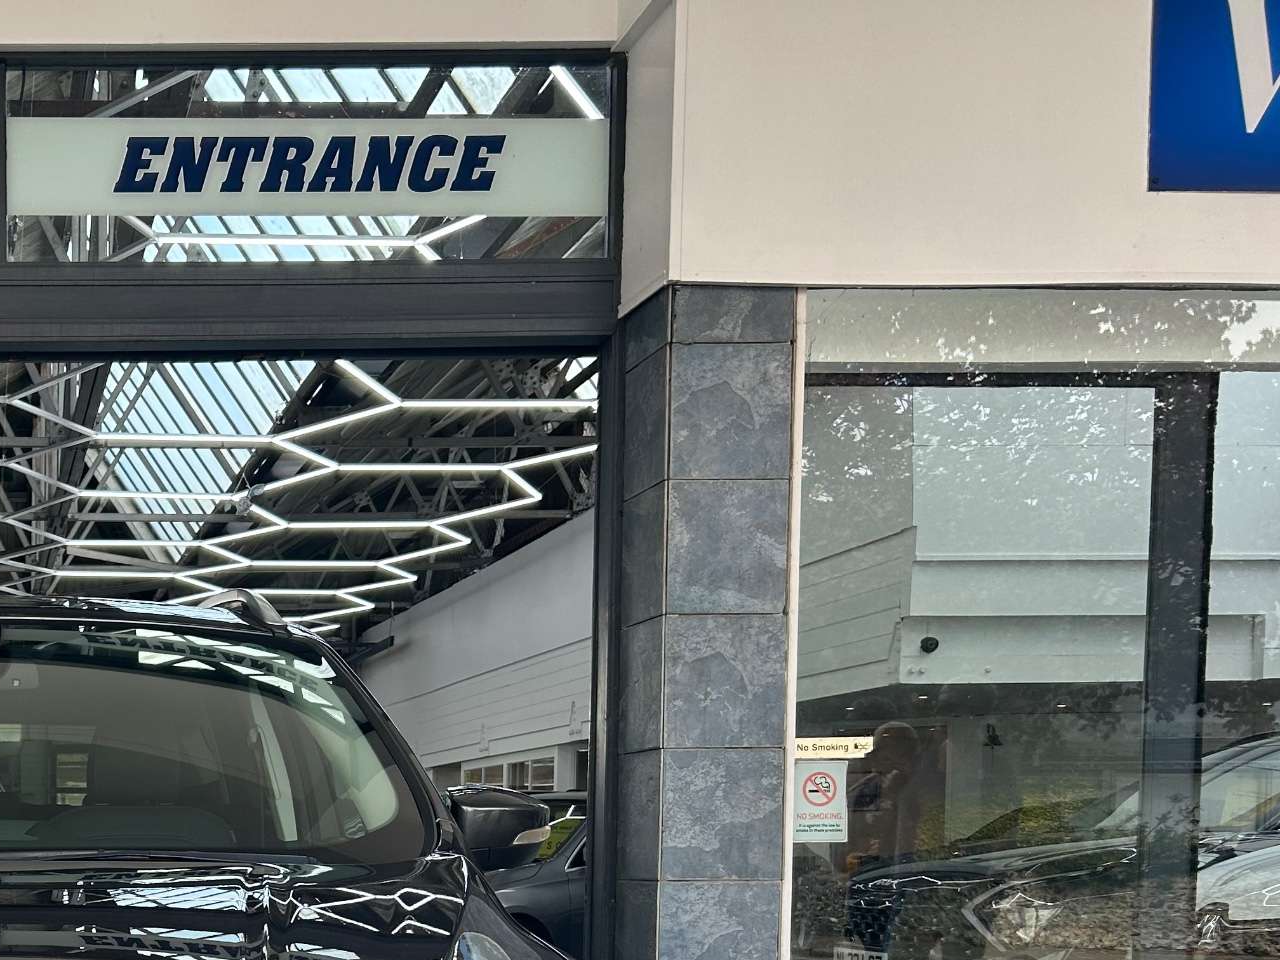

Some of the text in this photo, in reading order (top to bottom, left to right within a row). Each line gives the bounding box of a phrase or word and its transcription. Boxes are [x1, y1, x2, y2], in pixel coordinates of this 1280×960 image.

[113, 134, 507, 193] ENTRANCE
[797, 743, 849, 752] No Smoking
